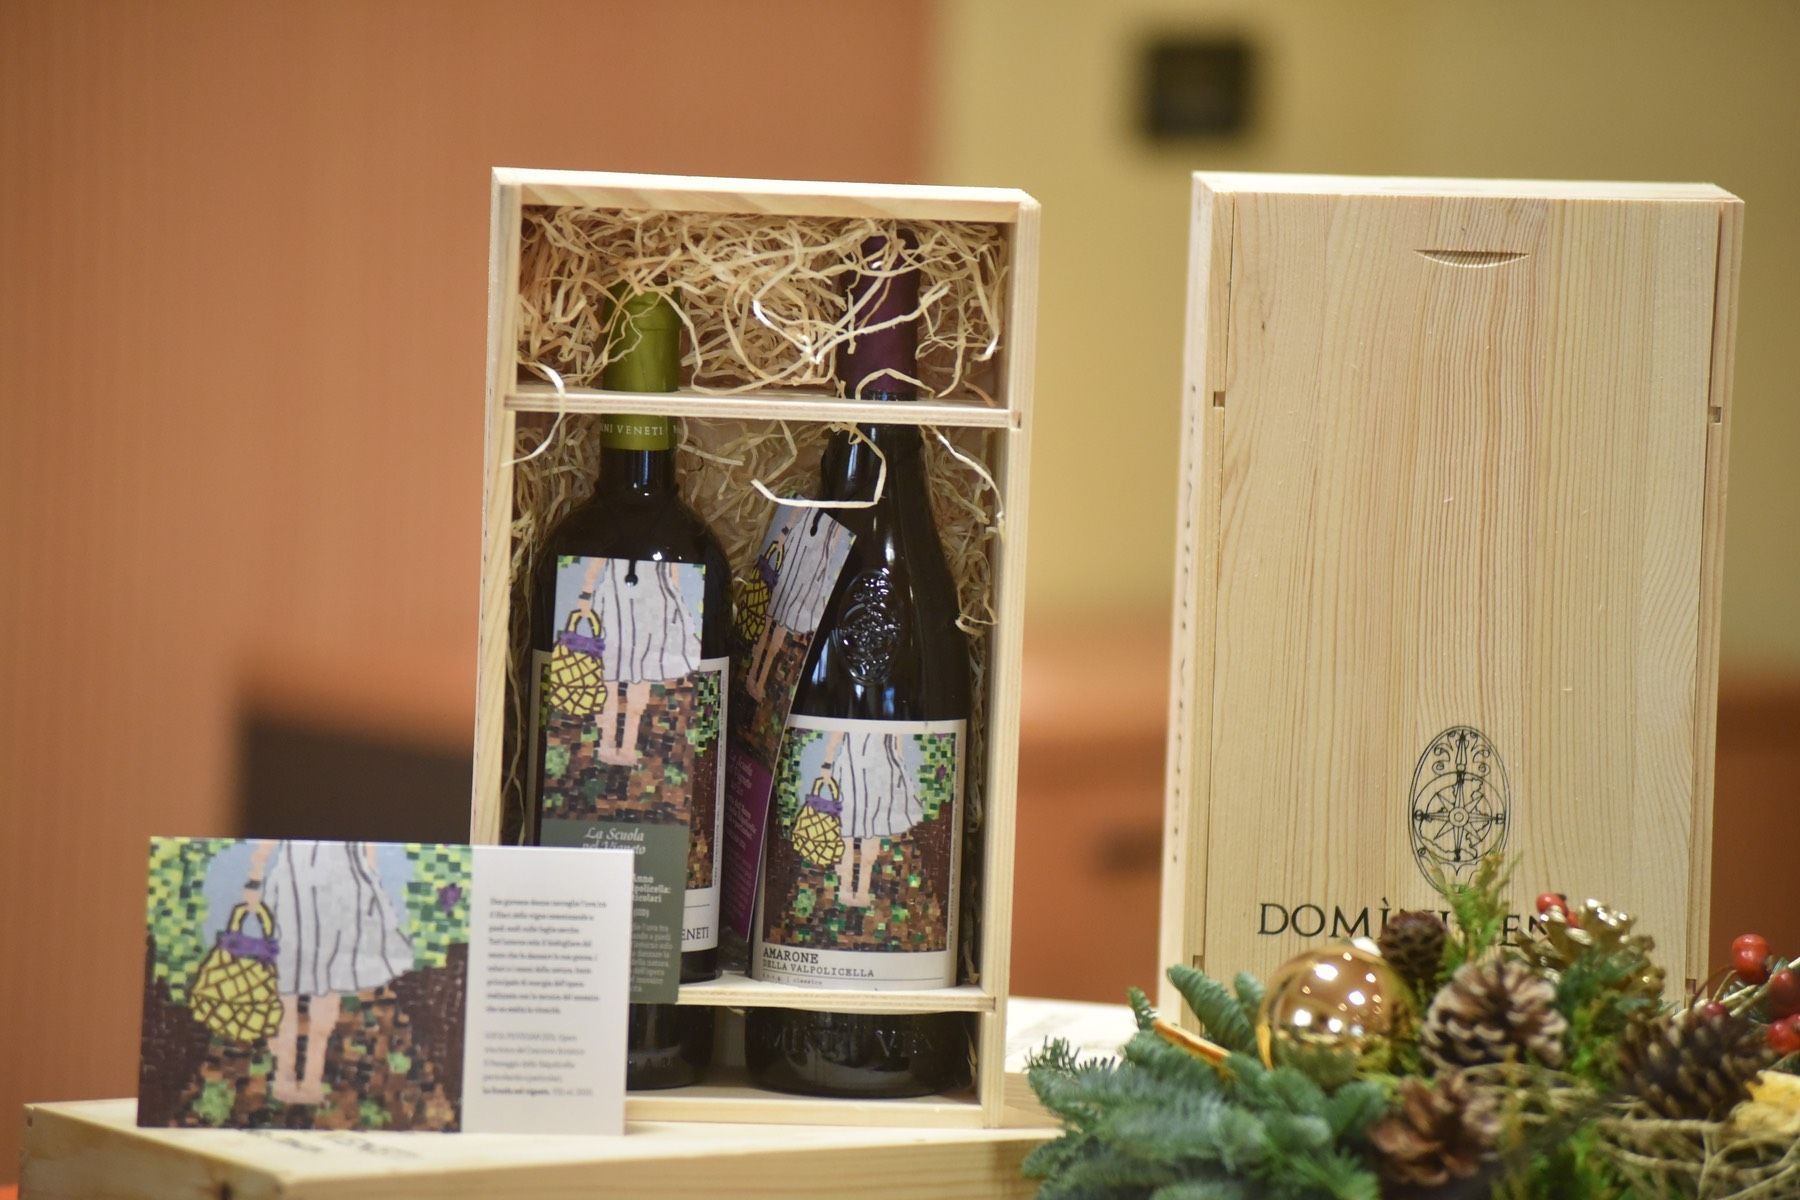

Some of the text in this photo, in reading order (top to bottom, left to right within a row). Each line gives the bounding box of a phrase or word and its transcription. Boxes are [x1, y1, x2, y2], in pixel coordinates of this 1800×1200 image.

[616, 425, 663, 436] VENETI
[584, 827, 645, 842] La Scuola
[1257, 897, 1451, 938] DOMÌI
[681, 926, 710, 941] ENETI
[763, 947, 819, 965] AMARONE
[763, 958, 875, 978] DELLA VALPOLICELLA
